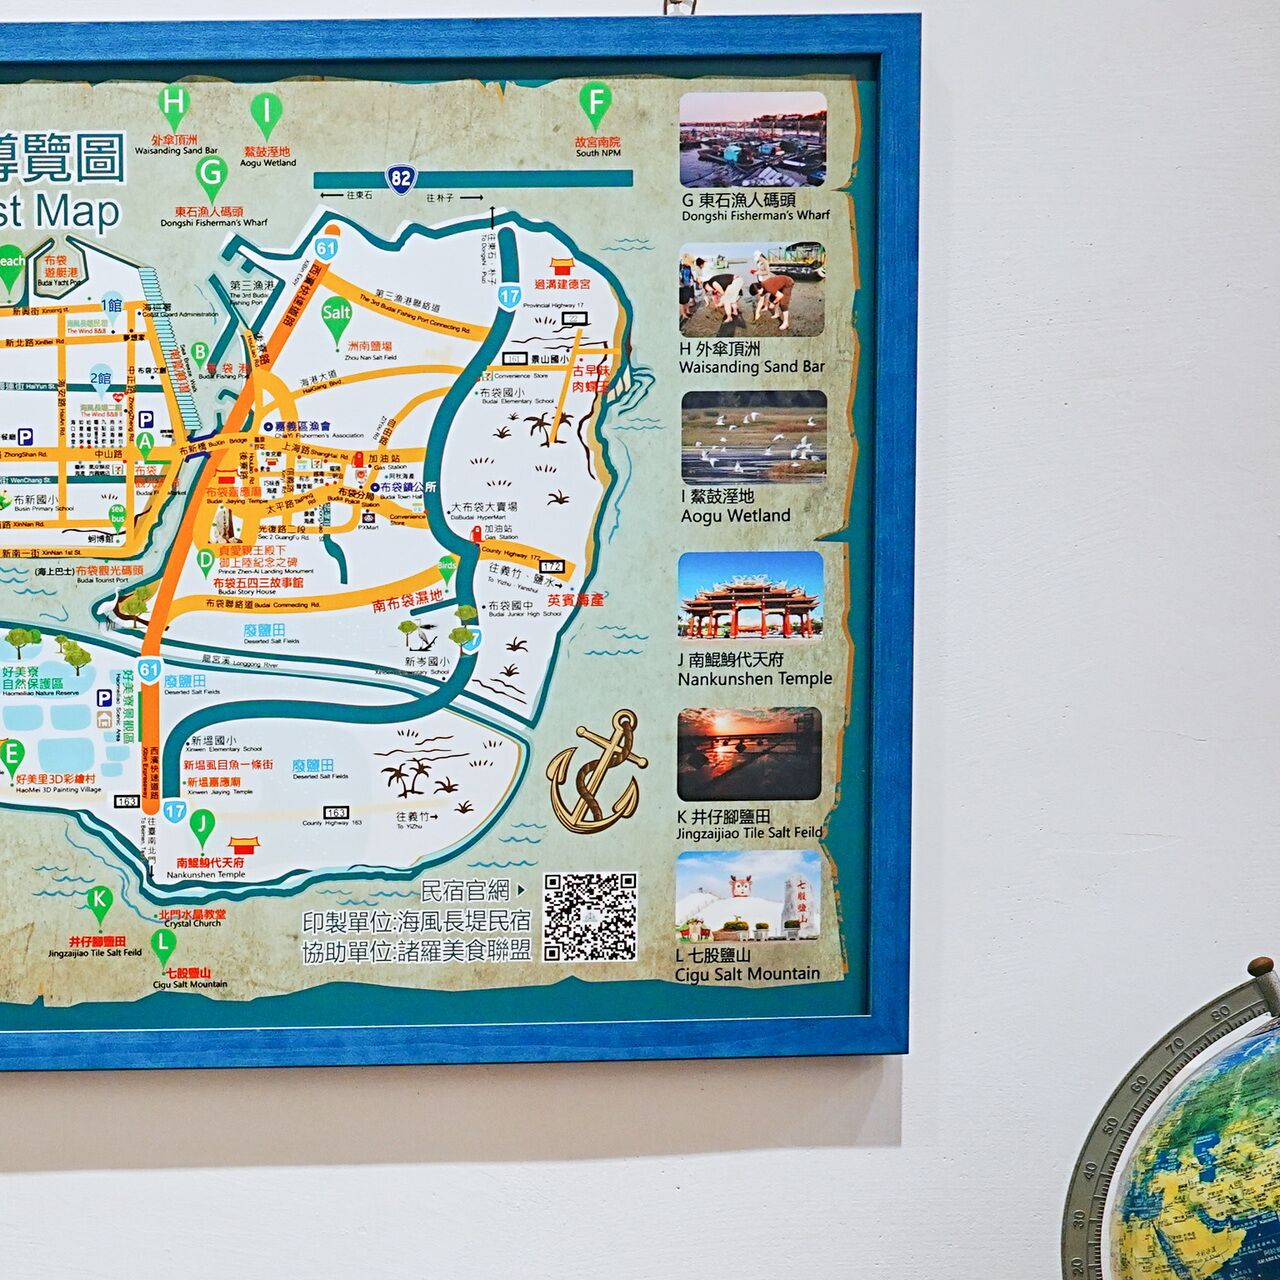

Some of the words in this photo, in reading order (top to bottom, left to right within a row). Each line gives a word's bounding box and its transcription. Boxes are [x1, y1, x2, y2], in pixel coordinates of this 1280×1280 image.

[151, 134, 198, 145] 外傘頂洲
[575, 136, 621, 148] 故宮南院
[135, 147, 180, 155] Waisanding
[576, 149, 599, 157] South
[602, 149, 621, 157] NPM
[240, 159, 262, 168] Aogu
[391, 170, 411, 186] 82
[347, 190, 372, 200] 往東石
[682, 193, 693, 207] G
[699, 193, 796, 208] 東石漁人碼頭
[37, 193, 120, 234] Map
[682, 210, 727, 223] Dongshi
[731, 211, 793, 221] Fisherman's
[797, 210, 830, 220] Wharf
[317, 241, 336, 255] 61
[501, 290, 519, 303] 17
[323, 305, 351, 319] Salt
[680, 342, 691, 355] H
[696, 341, 760, 357] 外傘頂洲
[680, 361, 759, 376] Waisanding
[764, 361, 797, 373] Sand
[804, 360, 825, 373] Bar
[681, 510, 721, 526] Aogu
[728, 508, 790, 522] Wetland
[213, 578, 304, 588] 布袋五四三故事館
[244, 623, 285, 637] 廢鹽田
[678, 654, 684, 667] J
[678, 672, 773, 685] Nankunshen
[778, 671, 832, 688] Temple
[328, 809, 345, 817] 163
[678, 810, 687, 823] K
[692, 809, 770, 825] 井仔腳鹽田
[676, 827, 739, 842] Jingzaijiao
[744, 828, 764, 839] Tile
[768, 827, 790, 838] Salt
[794, 827, 823, 838] Feild
[421, 880, 509, 902] 民宿官網
[165, 920, 191, 928] Crystal
[303, 911, 531, 934] 印製單位:海風長堤民宿
[303, 940, 531, 964] 協助單位:諸羅美食聯盟
[676, 949, 683, 962] L
[688, 947, 751, 963] 七股鹽山
[675, 969, 708, 985] Cigu
[715, 968, 742, 981] Salt
[748, 967, 820, 981] Mountain
[153, 980, 171, 990] Cigu
[173, 980, 188, 988] Salt
[190, 980, 227, 988] Mountain
[1211, 1005, 1231, 1021] 80
[1166, 1036, 1185, 1054] 70
[1131, 1075, 1148, 1093] 60
[1103, 1117, 1120, 1136] 50
[1083, 1161, 1098, 1180] 40
[1073, 1209, 1086, 1228] 30
[1072, 1257, 1084, 1276] 20
